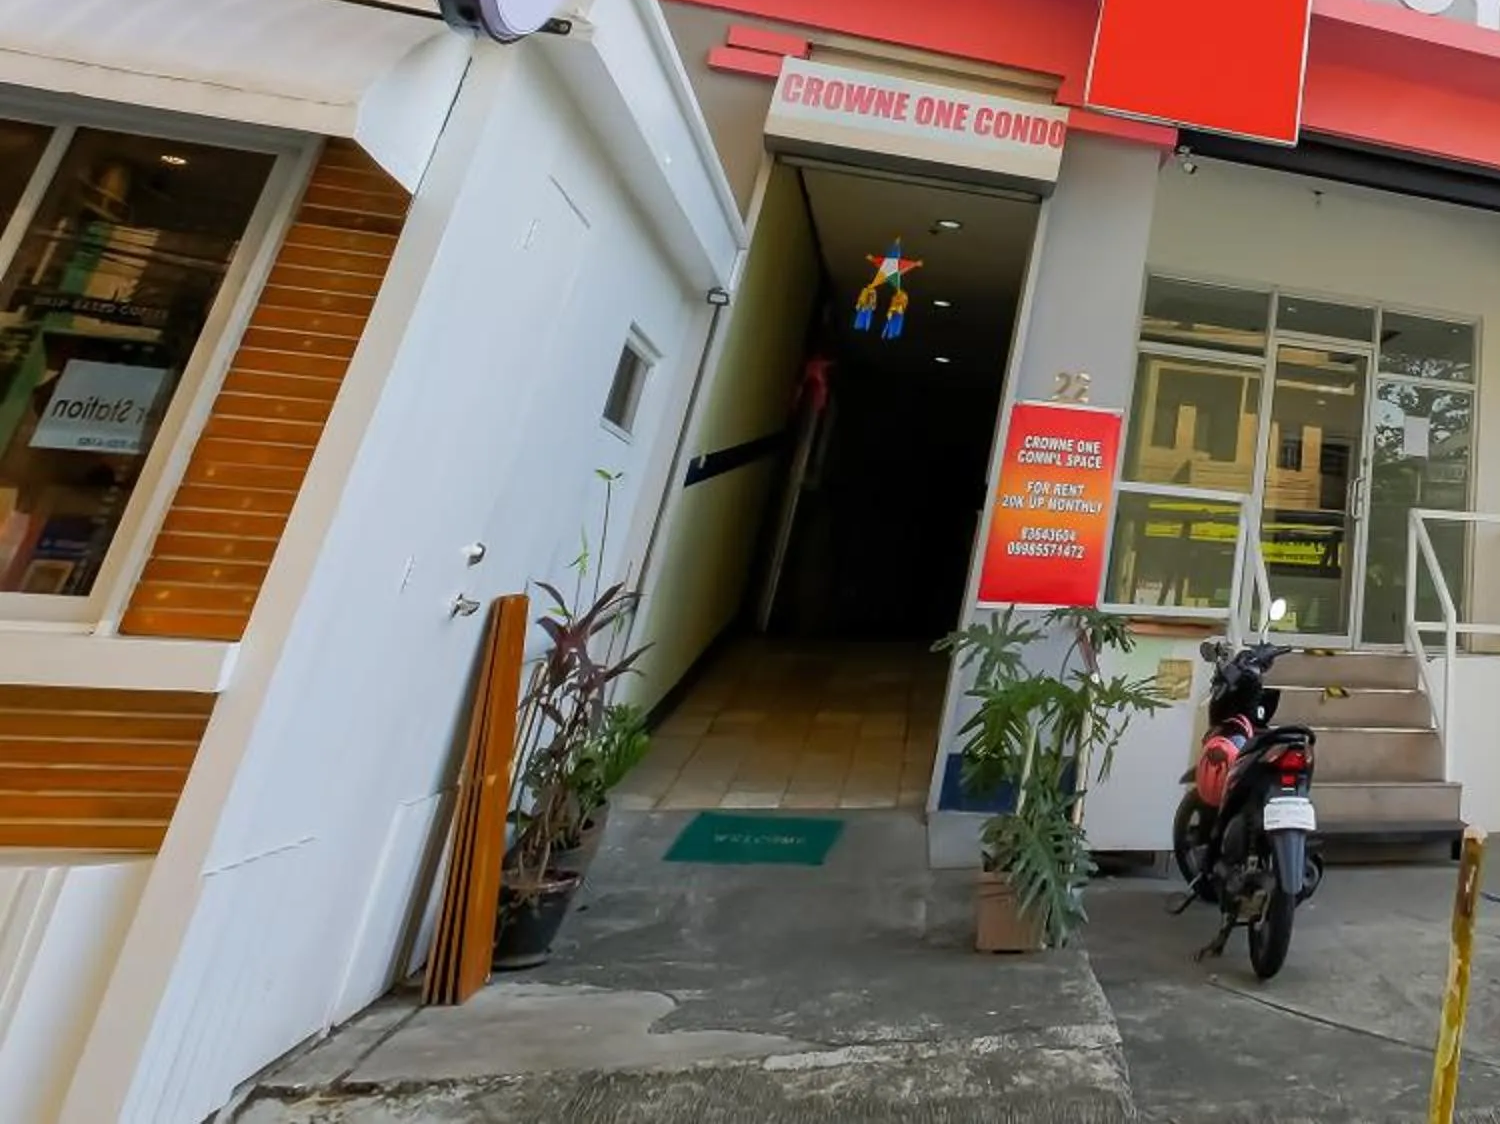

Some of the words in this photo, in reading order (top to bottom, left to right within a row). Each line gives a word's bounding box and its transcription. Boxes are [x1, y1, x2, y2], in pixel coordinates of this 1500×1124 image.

[782, 73, 910, 122] CROWNE
[914, 96, 969, 131] ONE
[973, 107, 1066, 148] CONDO
[1024, 435, 1073, 453] CROWNE
[1077, 440, 1101, 454] ONE
[1066, 453, 1103, 469] SPACE
[1026, 481, 1052, 496] FOR
[1053, 483, 1085, 498] RENT
[1028, 495, 1044, 509] UP
[1047, 497, 1103, 513] MONTHLY
